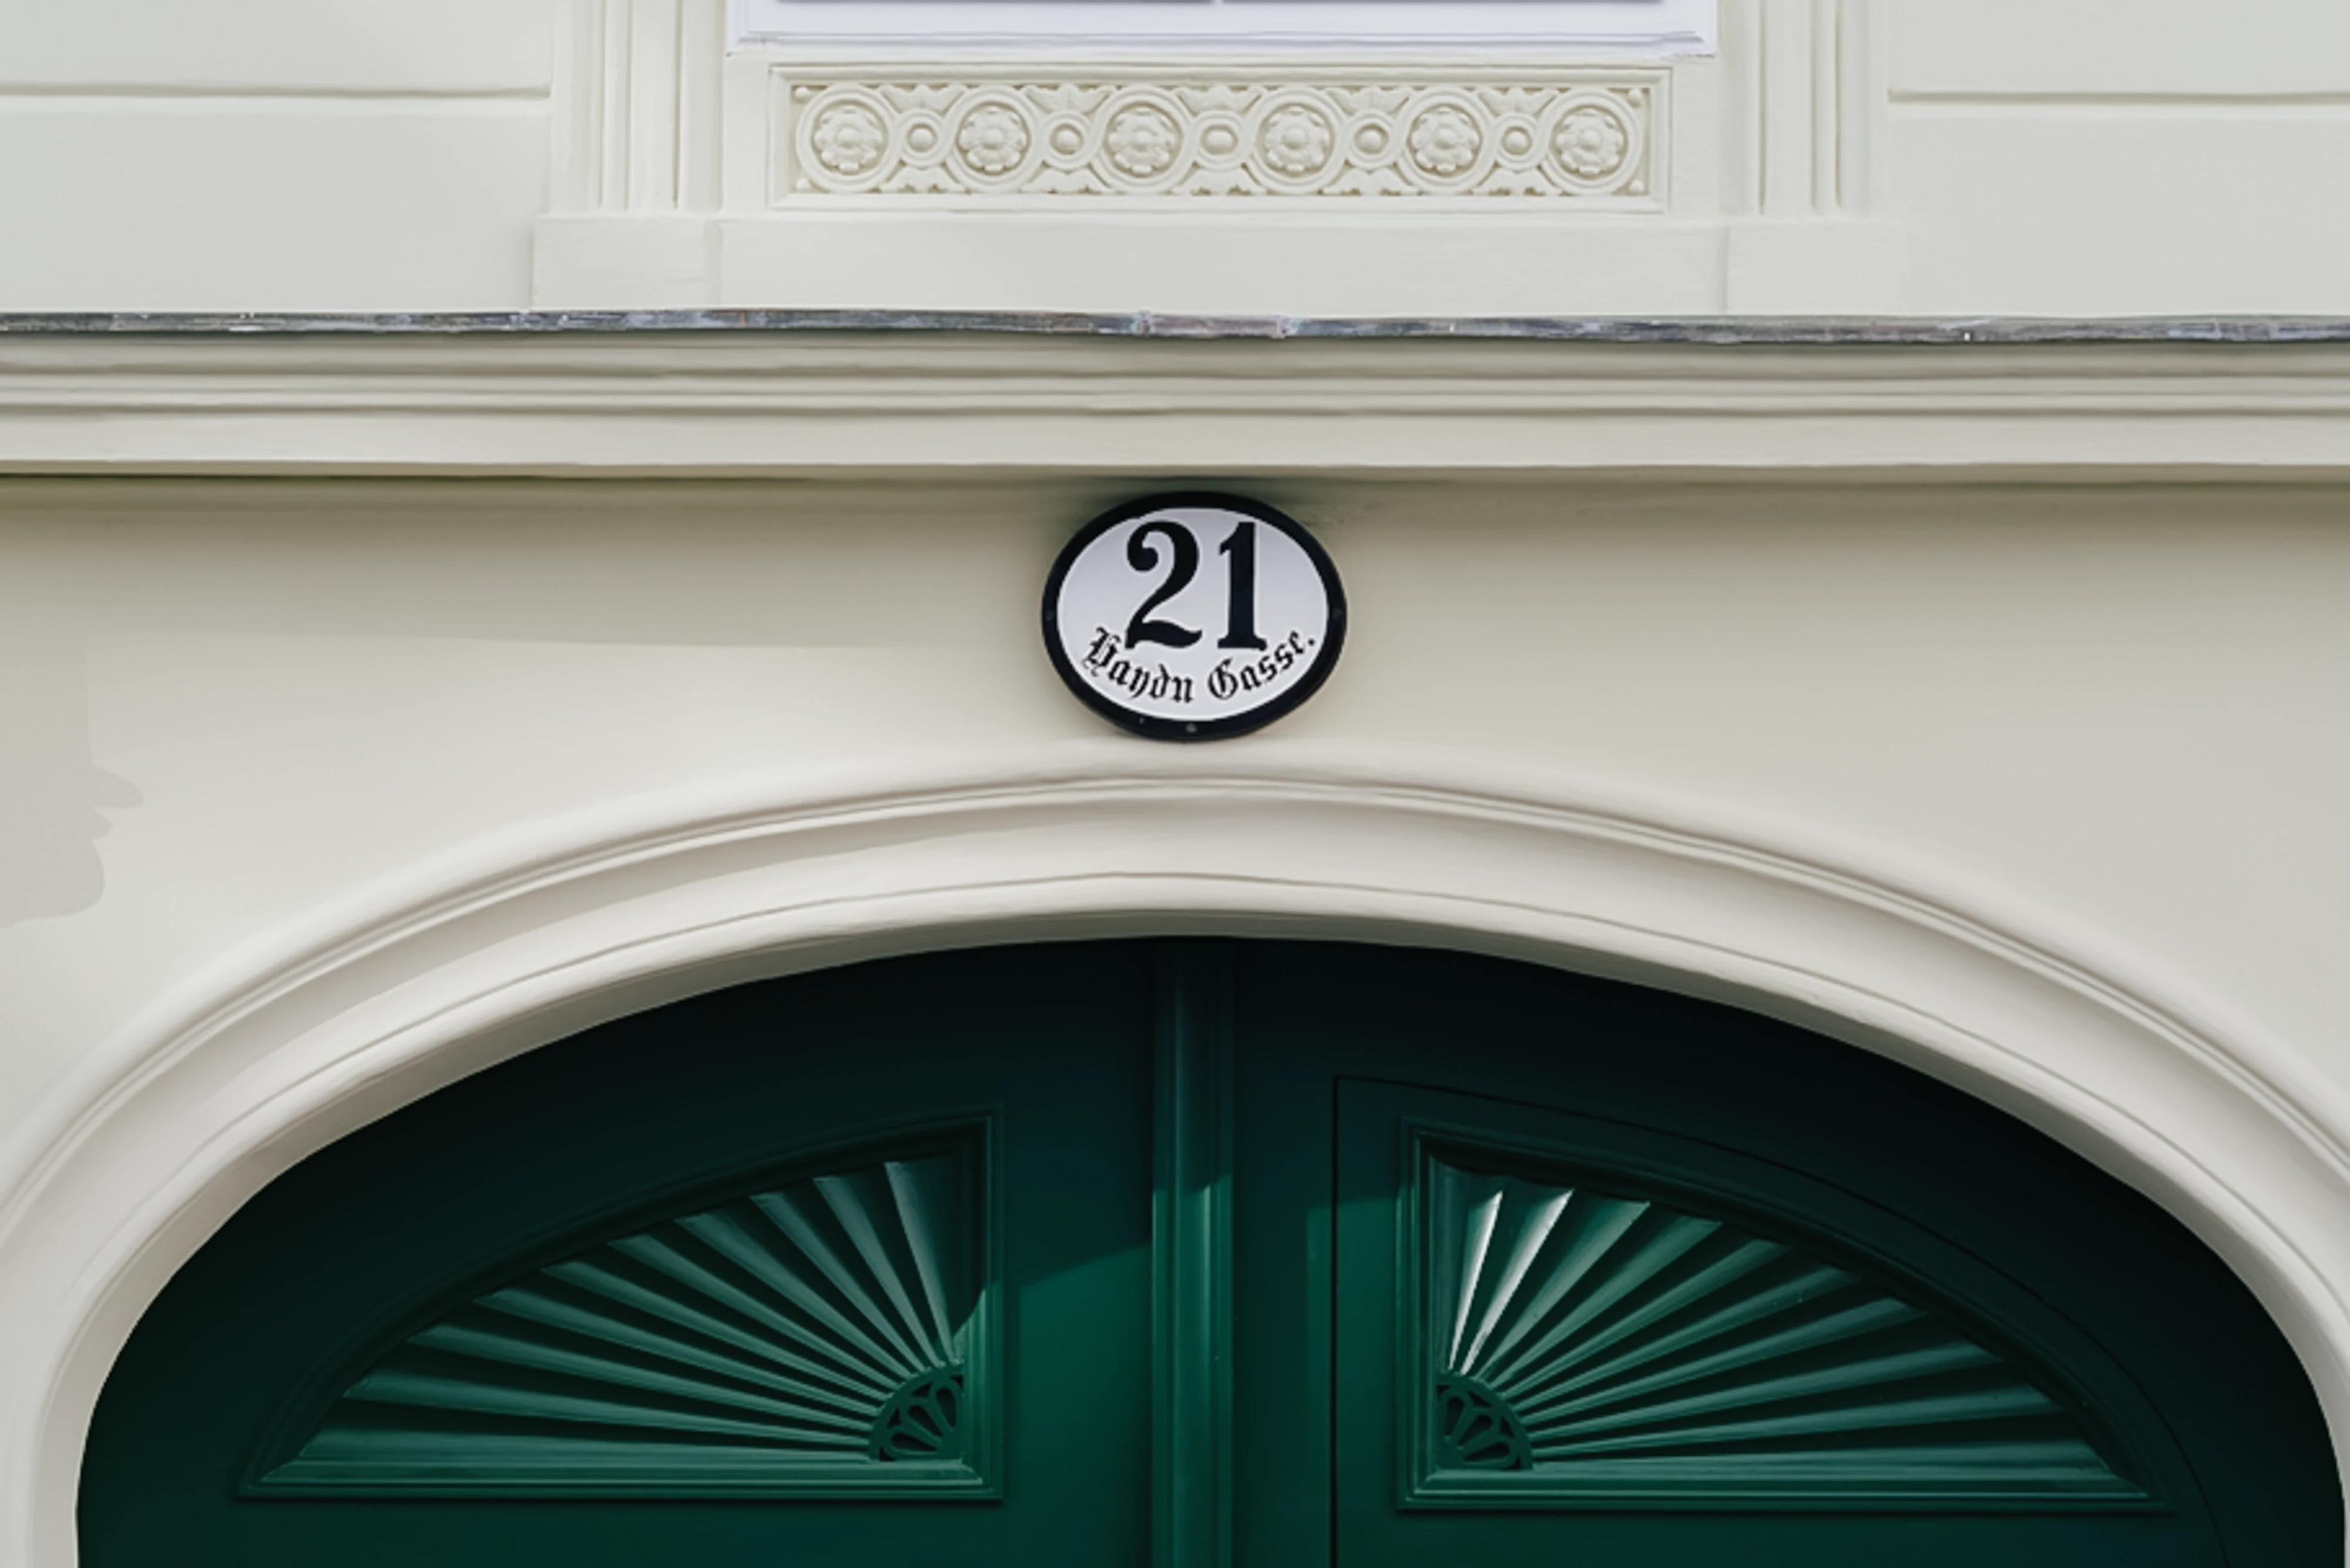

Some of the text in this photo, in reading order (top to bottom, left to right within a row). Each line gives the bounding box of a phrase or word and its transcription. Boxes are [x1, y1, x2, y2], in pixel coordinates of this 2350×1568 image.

[1124, 520, 1267, 652] 21
[1081, 626, 1315, 704] Haydn Gasse.
